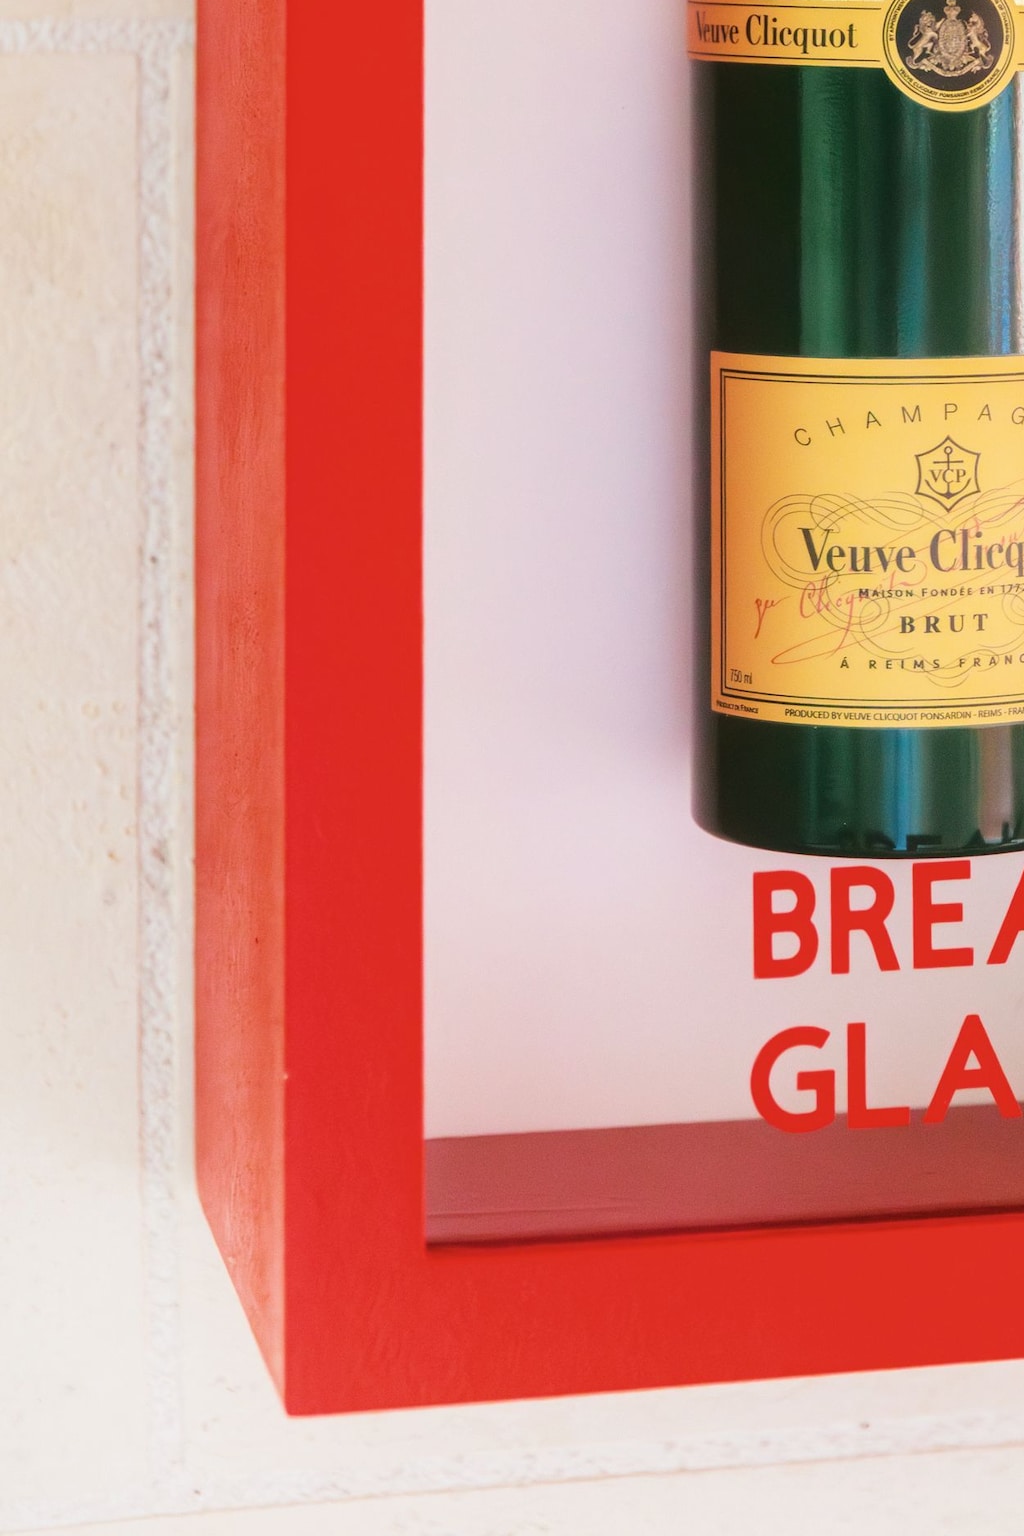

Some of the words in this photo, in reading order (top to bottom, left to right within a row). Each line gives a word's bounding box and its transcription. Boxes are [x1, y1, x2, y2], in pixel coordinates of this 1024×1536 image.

[695, 10, 740, 45] Veuve
[745, 13, 859, 55] Clicquot
[929, 468, 967, 484] VCP
[797, 527, 917, 573] Veuve
[859, 587, 914, 598] MAISON
[921, 585, 974, 597] FONDÉE
[980, 585, 995, 595] EN
[899, 613, 989, 634] BRUT
[868, 658, 942, 670] REIMS
[730, 668, 743, 684] 750
[784, 708, 830, 719] PRODUCED
[831, 711, 842, 720] BY
[843, 711, 872, 721] VEUVE
[873, 712, 918, 722] CLICQUOT
[920, 710, 972, 721] PONSARDIN
[978, 708, 1003, 719] REIMS
